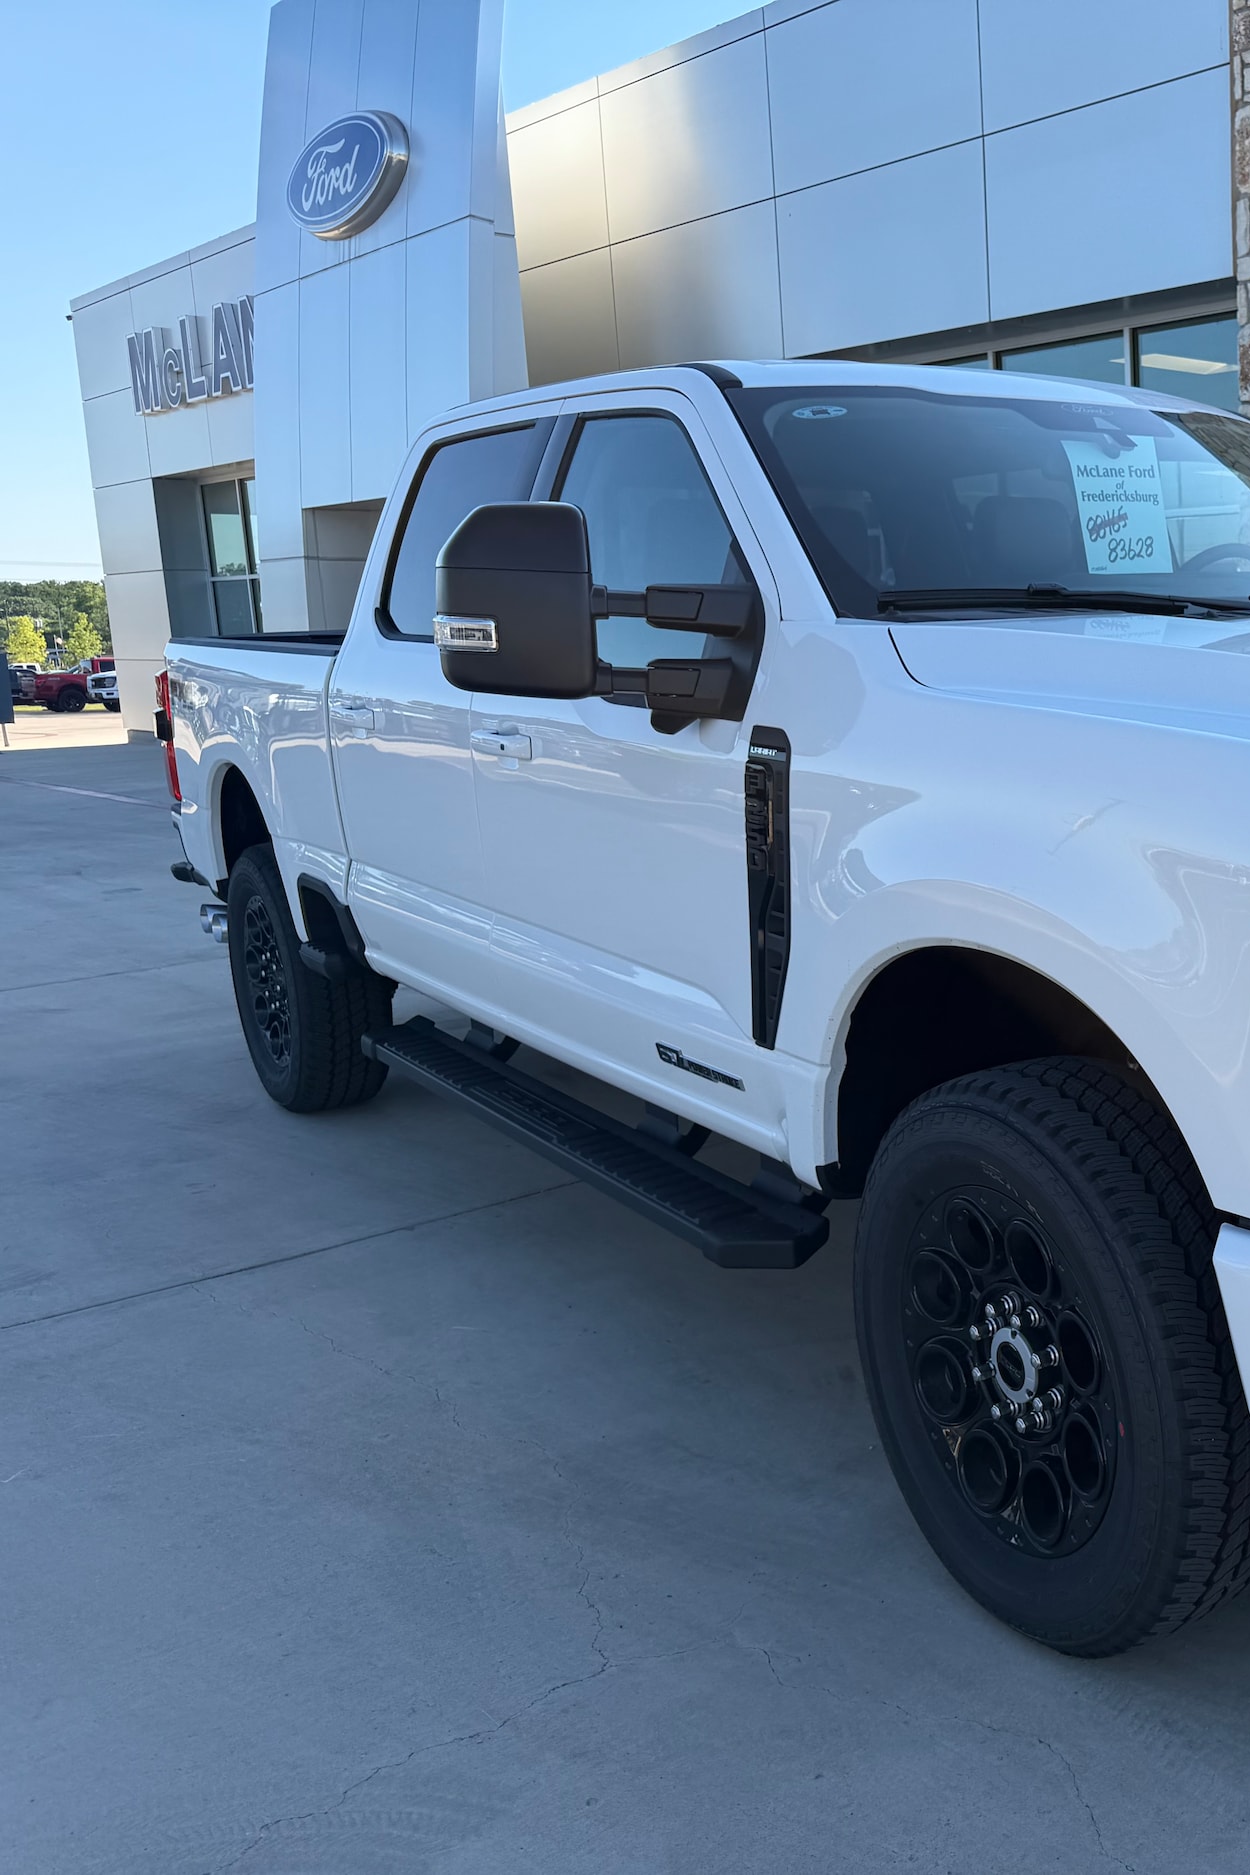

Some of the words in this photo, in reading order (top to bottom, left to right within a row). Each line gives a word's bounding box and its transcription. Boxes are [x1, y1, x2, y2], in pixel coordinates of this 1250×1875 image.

[301, 137, 360, 212] Ford
[1076, 464, 1126, 479] McLane
[1128, 465, 1156, 479] Ford
[1115, 480, 1125, 491] of
[1080, 490, 1160, 506] Fredericksburg
[1107, 535, 1154, 564] 83628
